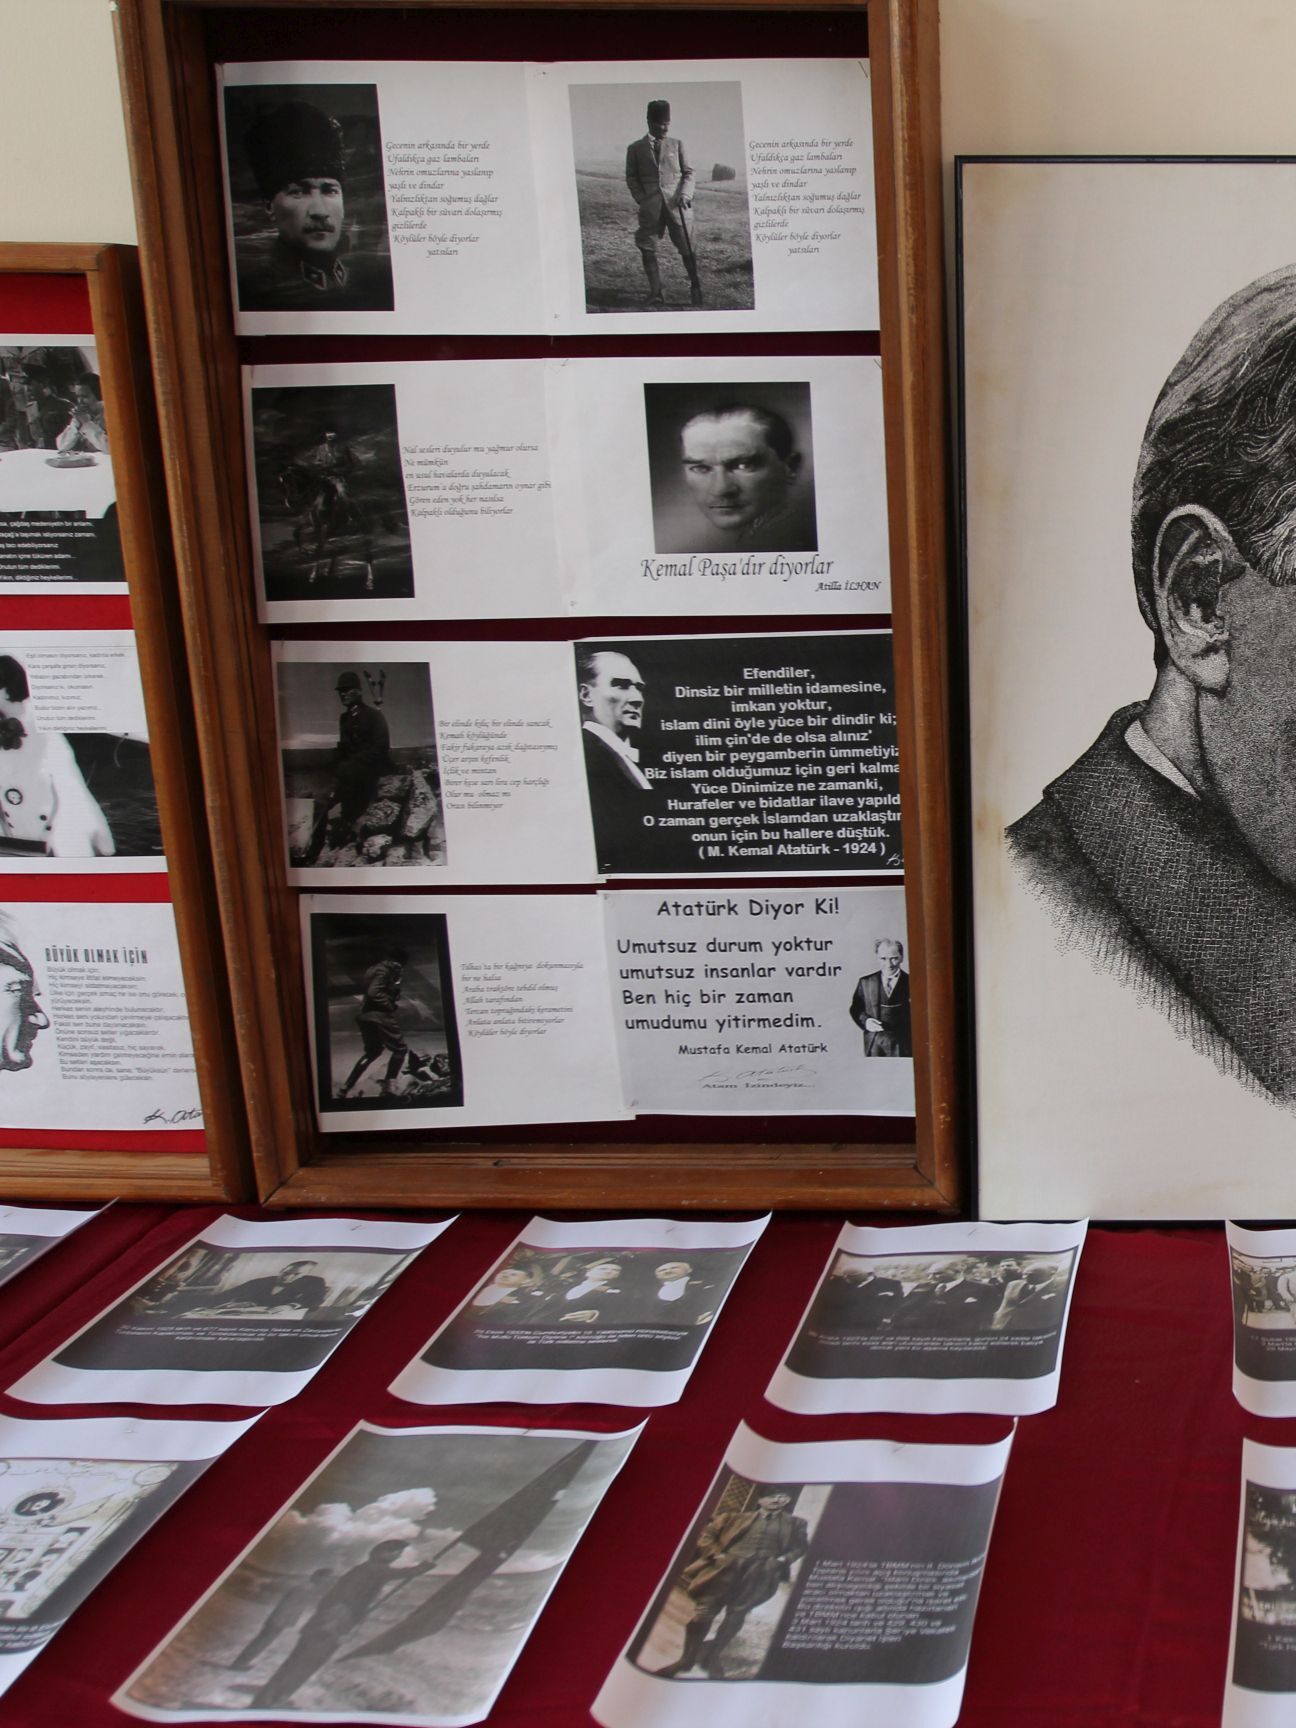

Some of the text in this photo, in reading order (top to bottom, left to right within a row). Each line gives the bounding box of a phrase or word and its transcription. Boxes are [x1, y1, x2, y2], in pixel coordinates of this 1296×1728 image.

[386, 142, 415, 152] Gecenin
[470, 141, 491, 152] yerde
[749, 141, 779, 151] Gecenin
[834, 139, 853, 150] yerde
[426, 156, 440, 165] gaz
[444, 154, 480, 163] lambaları
[790, 155, 804, 164] gaz
[807, 152, 843, 161] lambaları
[474, 194, 498, 205] dağlar
[836, 192, 861, 203] dağlar
[641, 554, 835, 582] Kemal Paşa'dır diyorlar
[844, 580, 882, 591] İLHAN
[743, 667, 816, 680] Efendiler,
[676, 681, 886, 698] Dinsiz bir milletin idamesine,
[731, 699, 832, 714] imkan yoktur,
[661, 713, 898, 732] islam dini öyle yüce bir dindir ki;
[696, 735, 722, 746] ilim
[726, 733, 770, 748] çin'de
[774, 733, 793, 744] de
[796, 732, 827, 743] olsa
[663, 751, 702, 765] diyen
[706, 751, 726, 761] bir
[730, 748, 826, 765] peygamberin
[644, 768, 668, 779] Biz
[670, 767, 709, 778] islam
[712, 766, 792, 780] olduğumuz
[796, 764, 822, 778] için
[827, 763, 855, 777] geri
[692, 779, 884, 795] Yüce Dinimize ne zamanki,
[668, 798, 735, 811] Hurafeler
[739, 800, 756, 809] ve
[759, 797, 816, 808] bidatlar
[820, 795, 854, 807] ilave
[644, 816, 655, 827] O
[659, 815, 706, 827] zaman
[710, 813, 760, 828] gerçek
[692, 827, 890, 844] onun için bu hallere düştük.
[729, 845, 773, 857] Kemal
[777, 843, 831, 856] Atatürk
[842, 843, 877, 855] 1924
[657, 897, 840, 921] Atatürk Diyor Ki!
[617, 936, 833, 956] Umutsuz durum yoktur
[45, 945, 149, 967] BÜYÜK OLMAK İÇİN
[620, 962, 843, 980] umutsuz insanlar vardır
[623, 990, 794, 1008] Ben hiç bir zaman
[625, 1013, 823, 1033] umudumu yitirmedim.
[678, 1043, 828, 1055] Mustafa Kemal Atatürk
